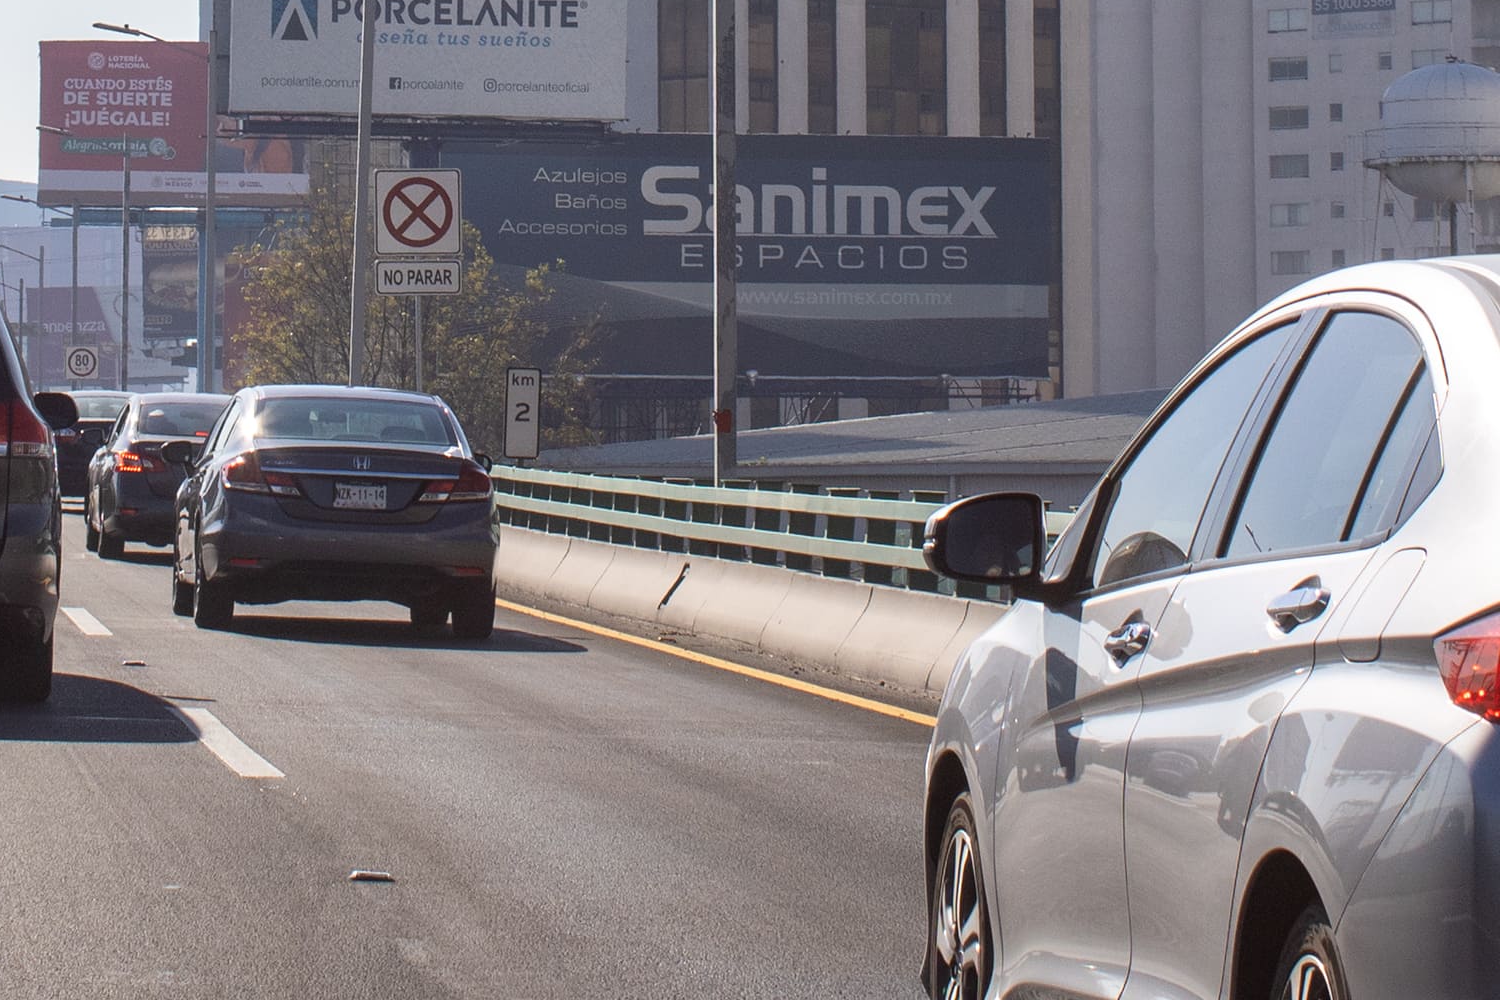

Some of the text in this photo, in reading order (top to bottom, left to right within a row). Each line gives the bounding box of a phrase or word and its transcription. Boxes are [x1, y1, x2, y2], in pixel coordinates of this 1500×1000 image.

[438, 31, 470, 46] tus
[478, 31, 552, 48] sueños
[63, 76, 173, 91] CUANDO ESTÉS
[63, 91, 173, 107] DE SUERTE
[65, 107, 170, 128] ¡JUÉGALE!
[533, 167, 627, 186] Azulejos
[555, 193, 627, 209] Baños
[498, 219, 628, 236] Accesorios
[384, 269, 453, 286] NO PARAR
[75, 354, 89, 367] 80
[512, 373, 535, 387] km
[515, 402, 531, 423] 2
